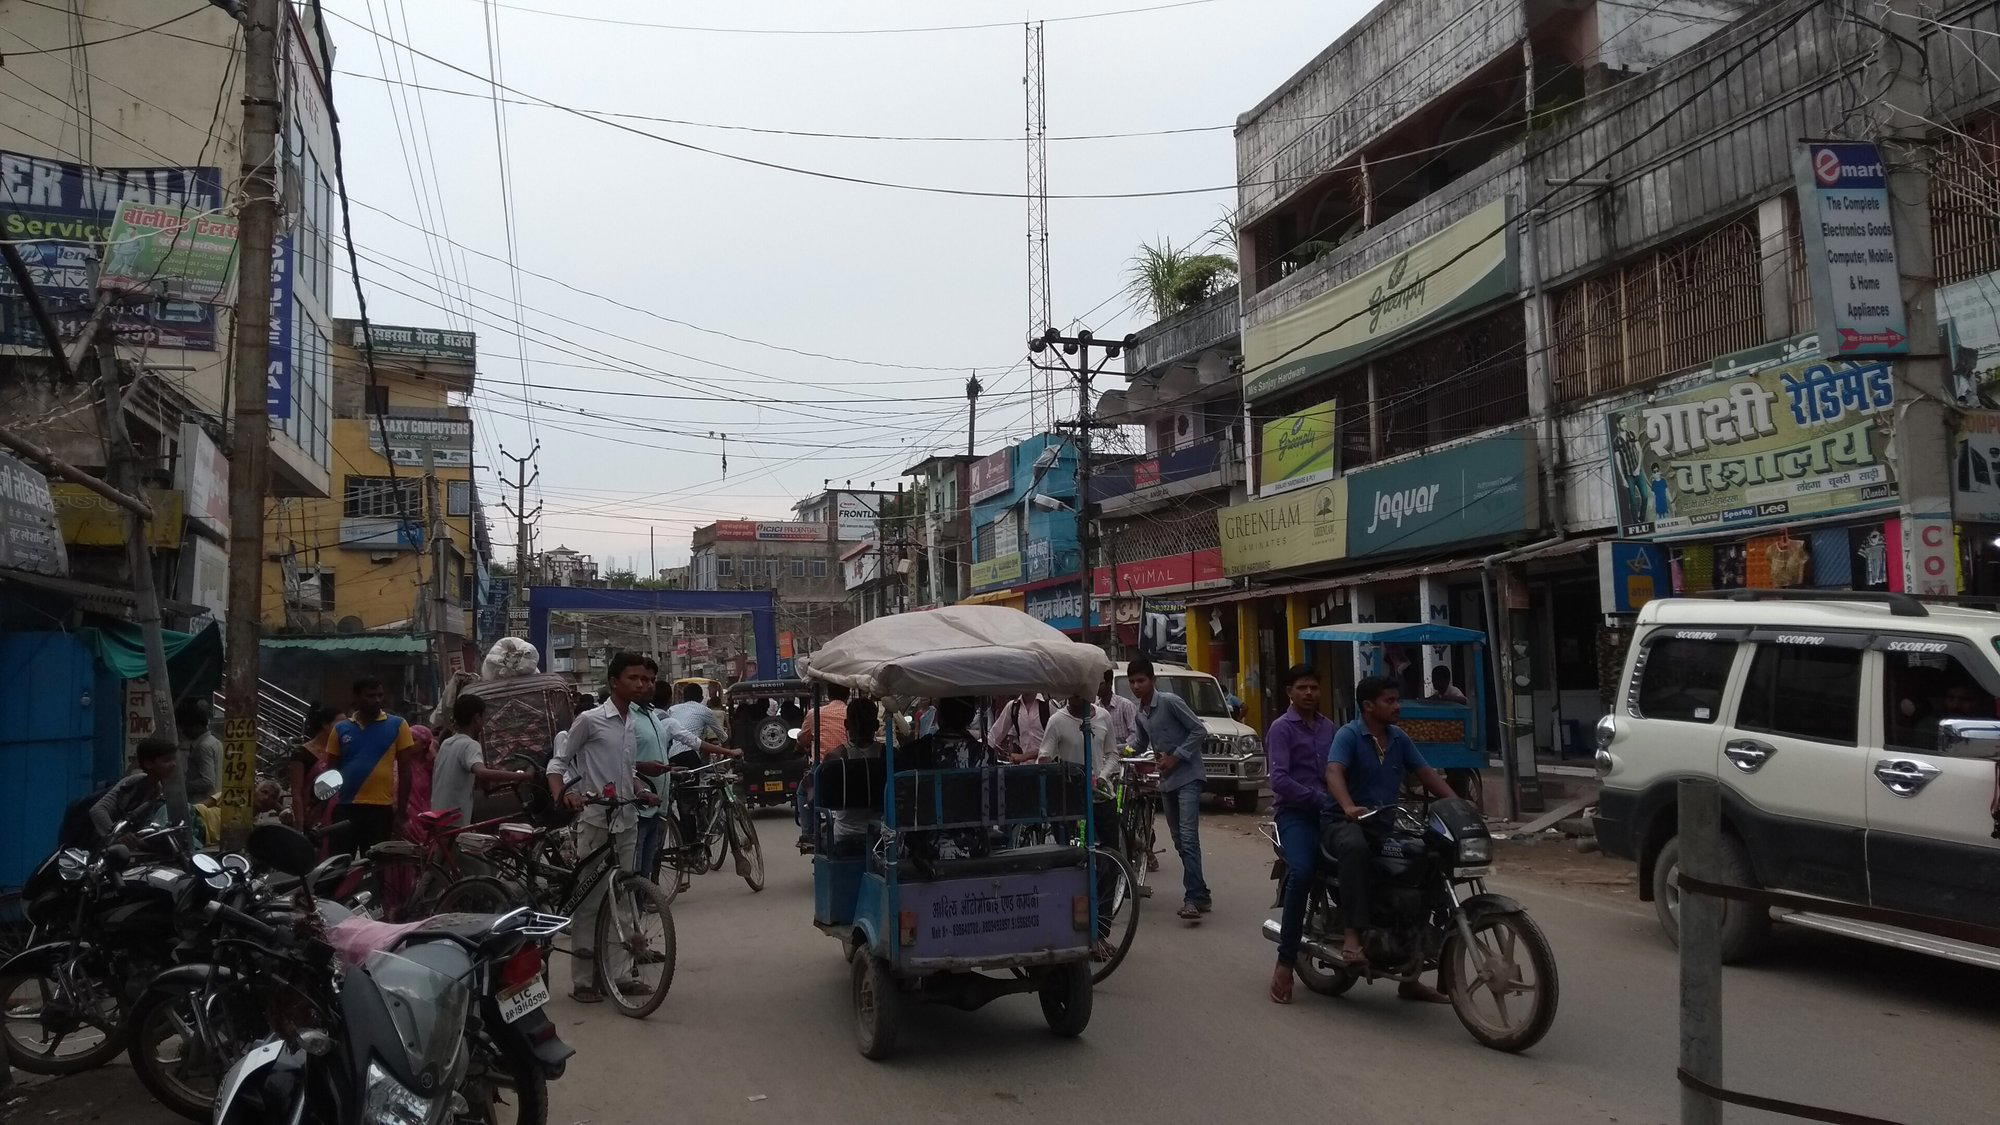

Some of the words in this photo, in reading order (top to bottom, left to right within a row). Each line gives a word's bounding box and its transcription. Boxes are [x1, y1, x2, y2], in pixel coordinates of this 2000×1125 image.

[1826, 196, 1842, 211] The
[1843, 196, 1880, 213] Complete
[1822, 222, 1866, 237] Electronics
[1867, 222, 1892, 237] Goods
[1827, 249, 1868, 266] Computer,
[1868, 249, 1893, 264] Mobile
[1849, 275, 1856, 290] &
[1857, 275, 1880, 290] Home
[1847, 303, 1890, 321] Appliances
[416, 329, 439, 345] गेस्ट
[442, 332, 473, 348] हाउस
[1258, 377, 1278, 392] Sanjay
[1277, 366, 1306, 384] Hardware
[370, 419, 409, 433] GALAXY
[411, 420, 469, 435] COMPUTERS
[1367, 483, 1440, 534] Jaquar
[1760, 503, 1787, 515] Lee
[762, 525, 783, 533] ICICI
[1225, 503, 1301, 540] GREENLAM
[1657, 521, 1679, 529] KILLER
[1133, 569, 1174, 585] VIMAL
[1675, 631, 1718, 640] SCORPIO
[1776, 635, 1825, 645] SCORPIO
[1887, 641, 1948, 652] SCORPIO
[225, 762, 247, 781] 49
[512, 988, 531, 1004] LIC
